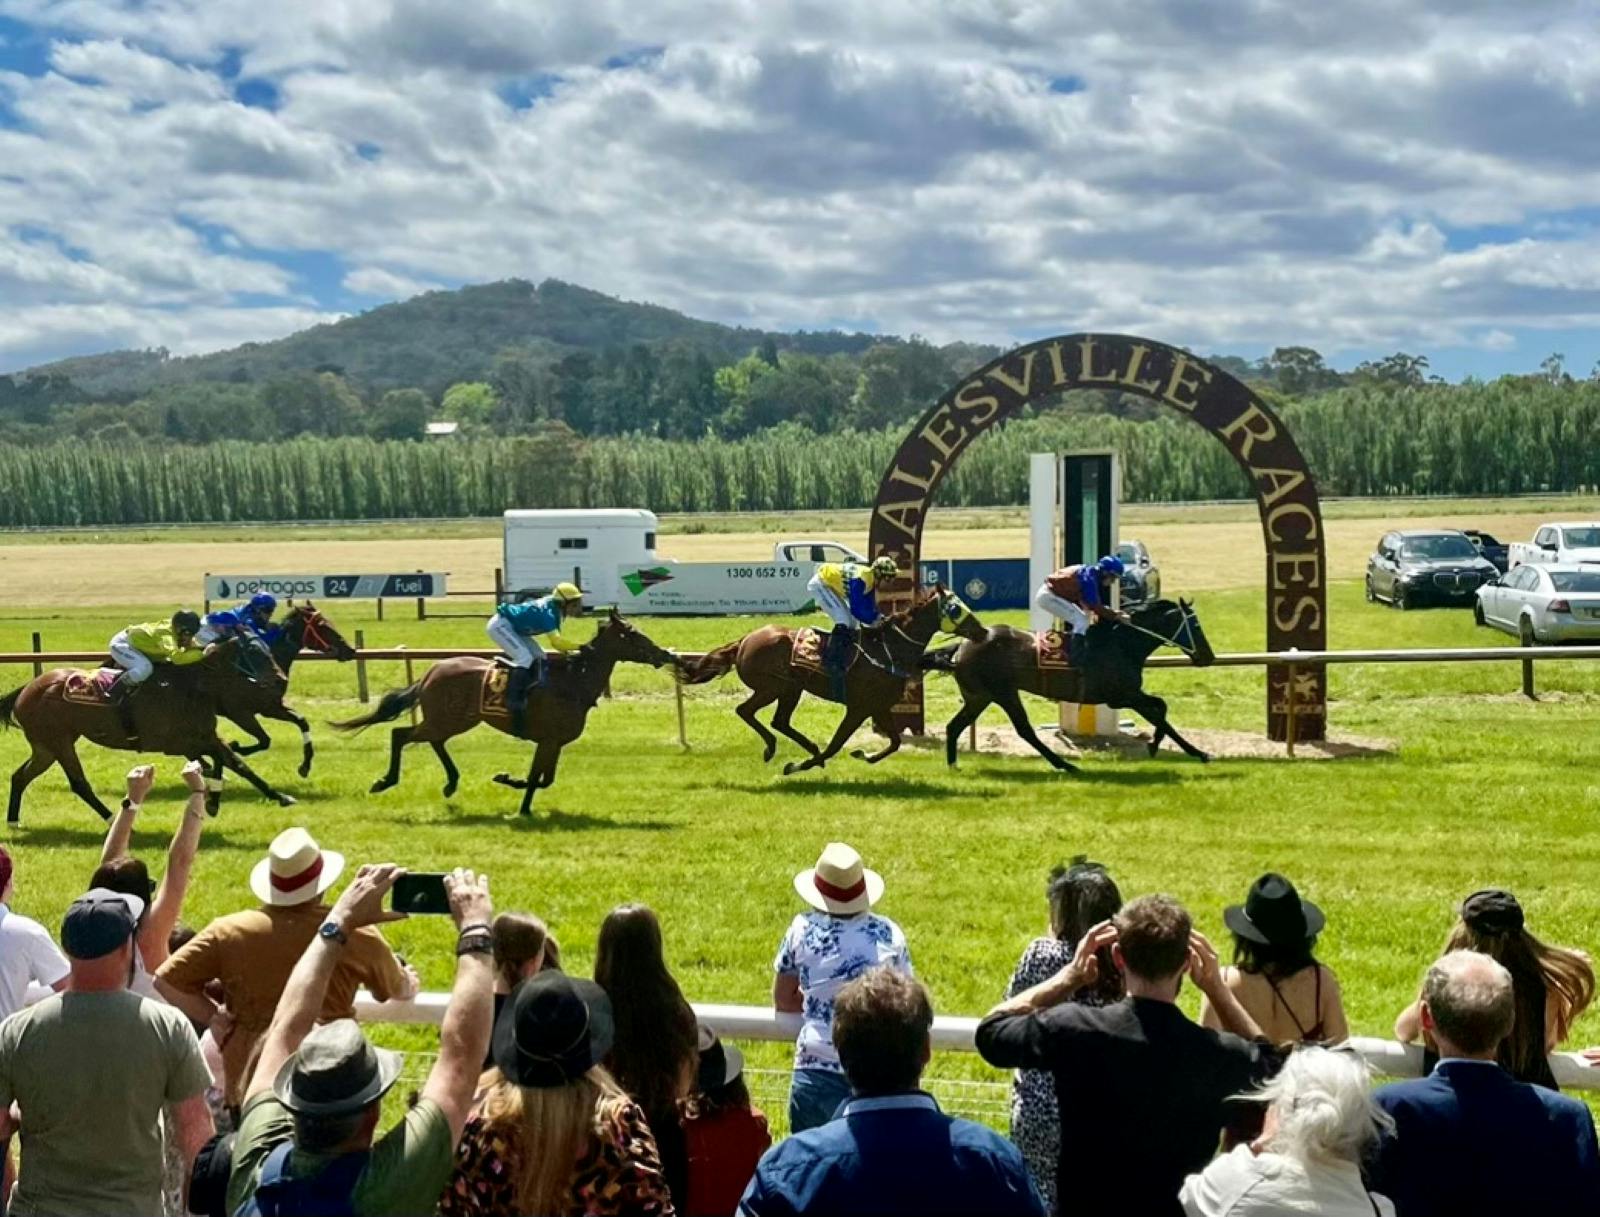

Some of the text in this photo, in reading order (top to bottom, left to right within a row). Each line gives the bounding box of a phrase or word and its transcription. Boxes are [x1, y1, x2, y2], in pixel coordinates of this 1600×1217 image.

[1218, 401, 1320, 632] RACES
[726, 566, 800, 578] 1300 652 576
[235, 579, 316, 599] petrogas
[328, 579, 348, 594] 24
